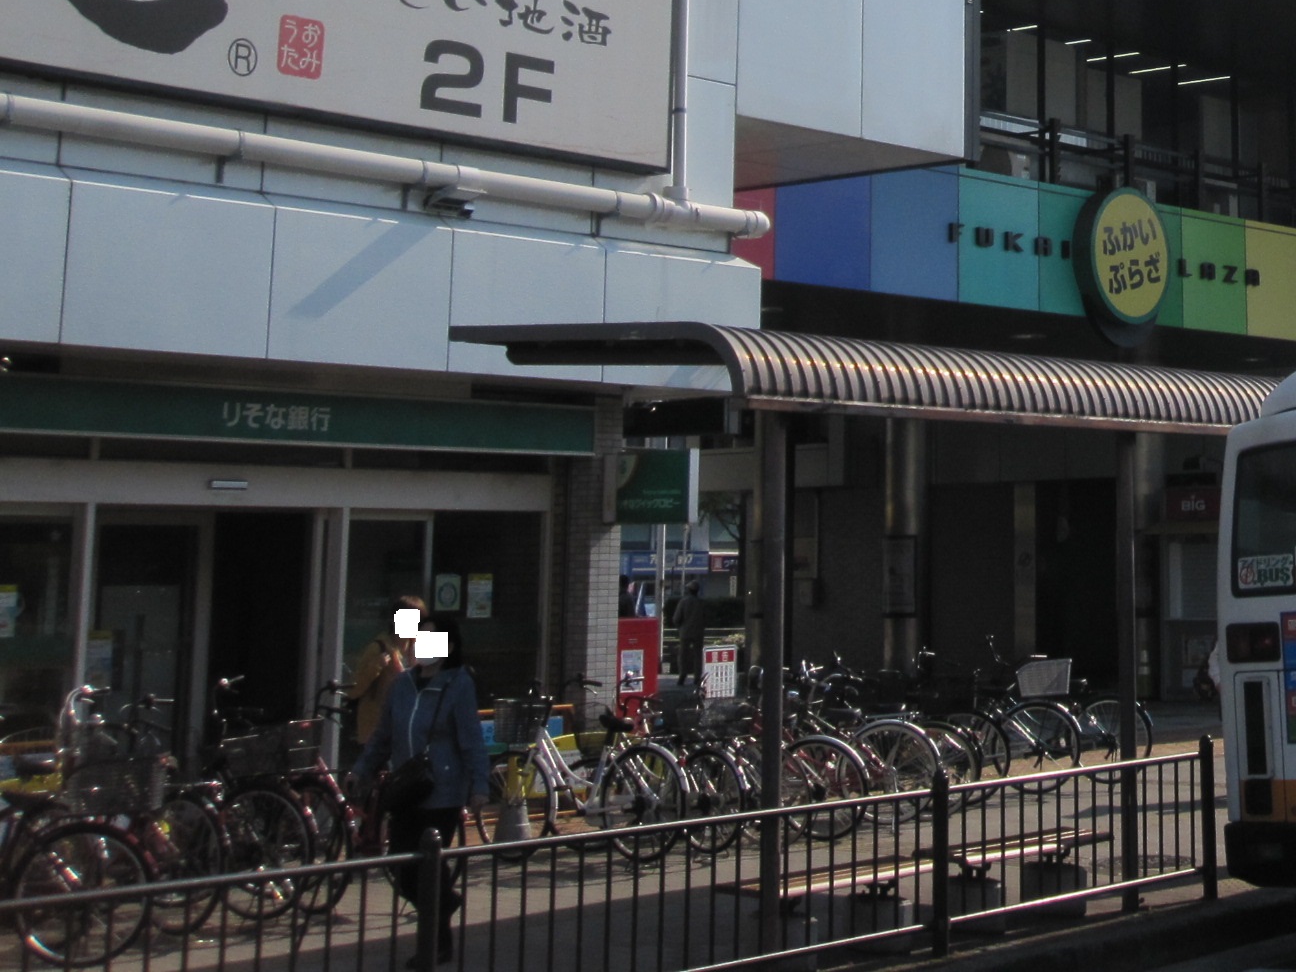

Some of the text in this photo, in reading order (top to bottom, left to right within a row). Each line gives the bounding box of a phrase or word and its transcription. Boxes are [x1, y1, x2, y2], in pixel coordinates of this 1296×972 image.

[419, 38, 556, 125] 2F
[947, 221, 1261, 287] FUKAI LAZA
[1103, 218, 1158, 256] ふかい
[1108, 251, 1161, 295] ぷらざ
[222, 402, 331, 432] りそな銀行
